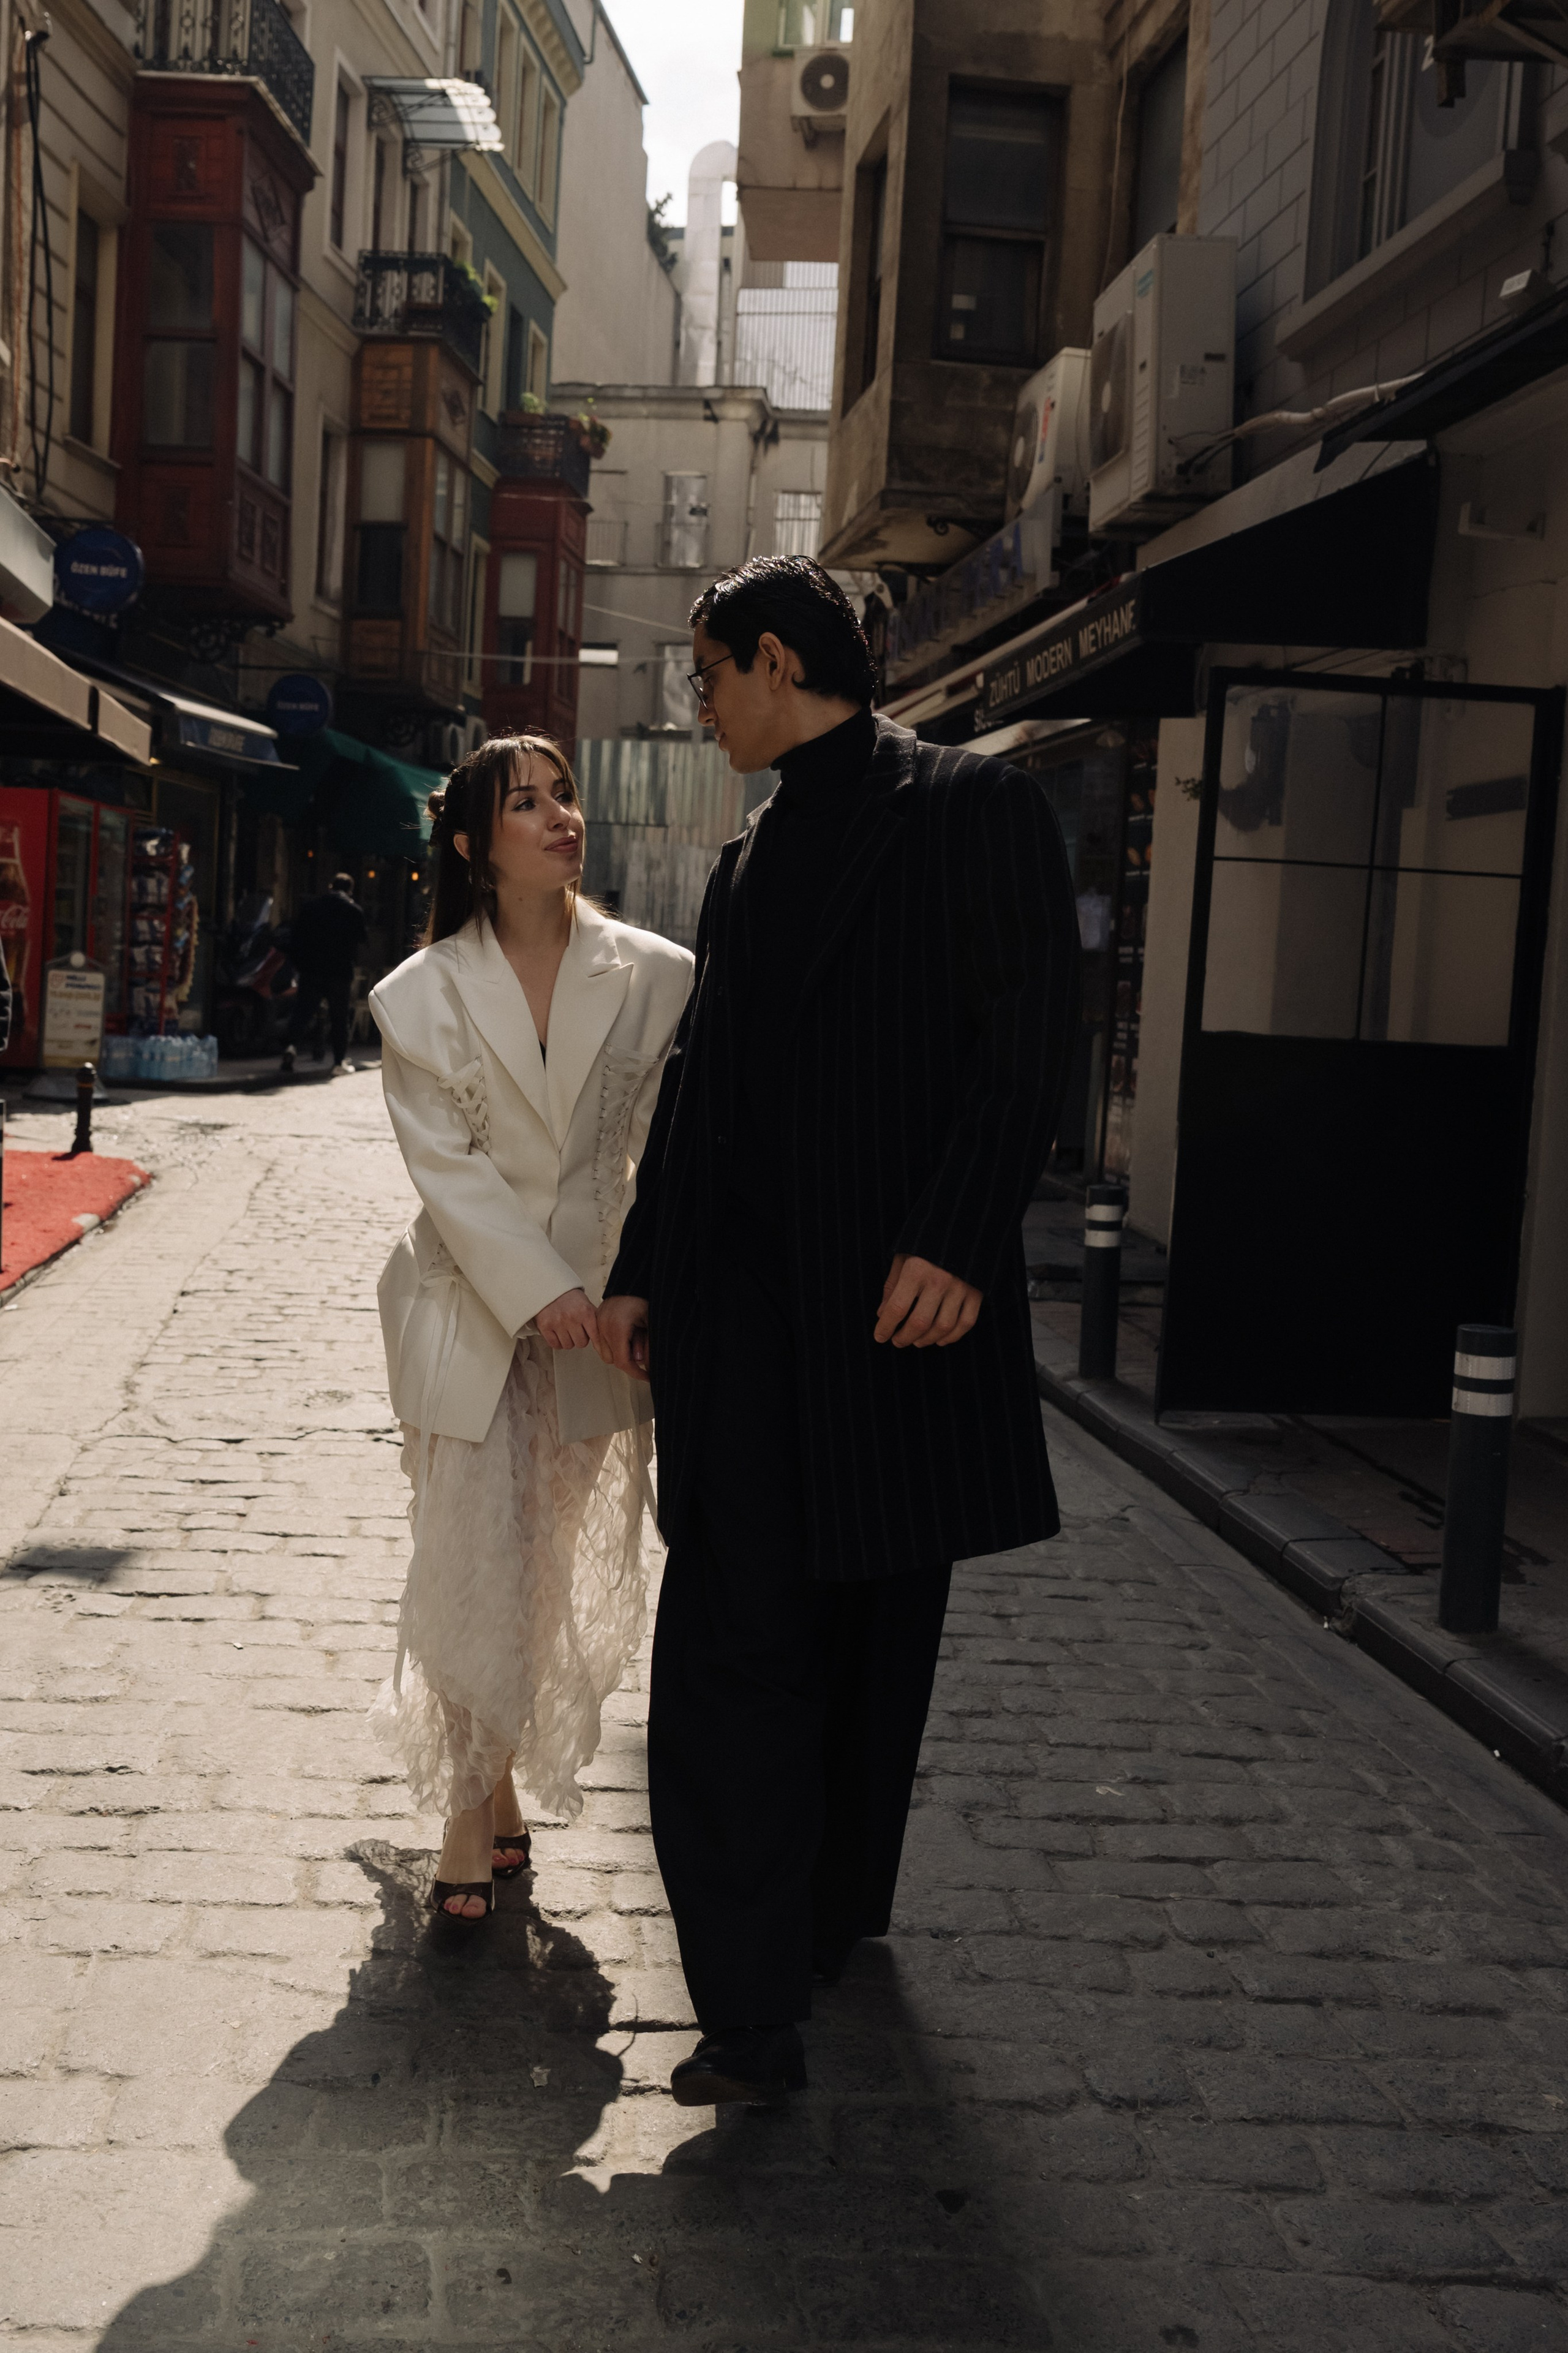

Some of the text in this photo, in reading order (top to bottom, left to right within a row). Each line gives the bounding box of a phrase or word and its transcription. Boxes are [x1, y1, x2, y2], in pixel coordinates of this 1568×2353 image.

[99, 564, 127, 579] BÜFE
[989, 599, 1136, 708] ZÜHTÜ MODERN MEYHANE
